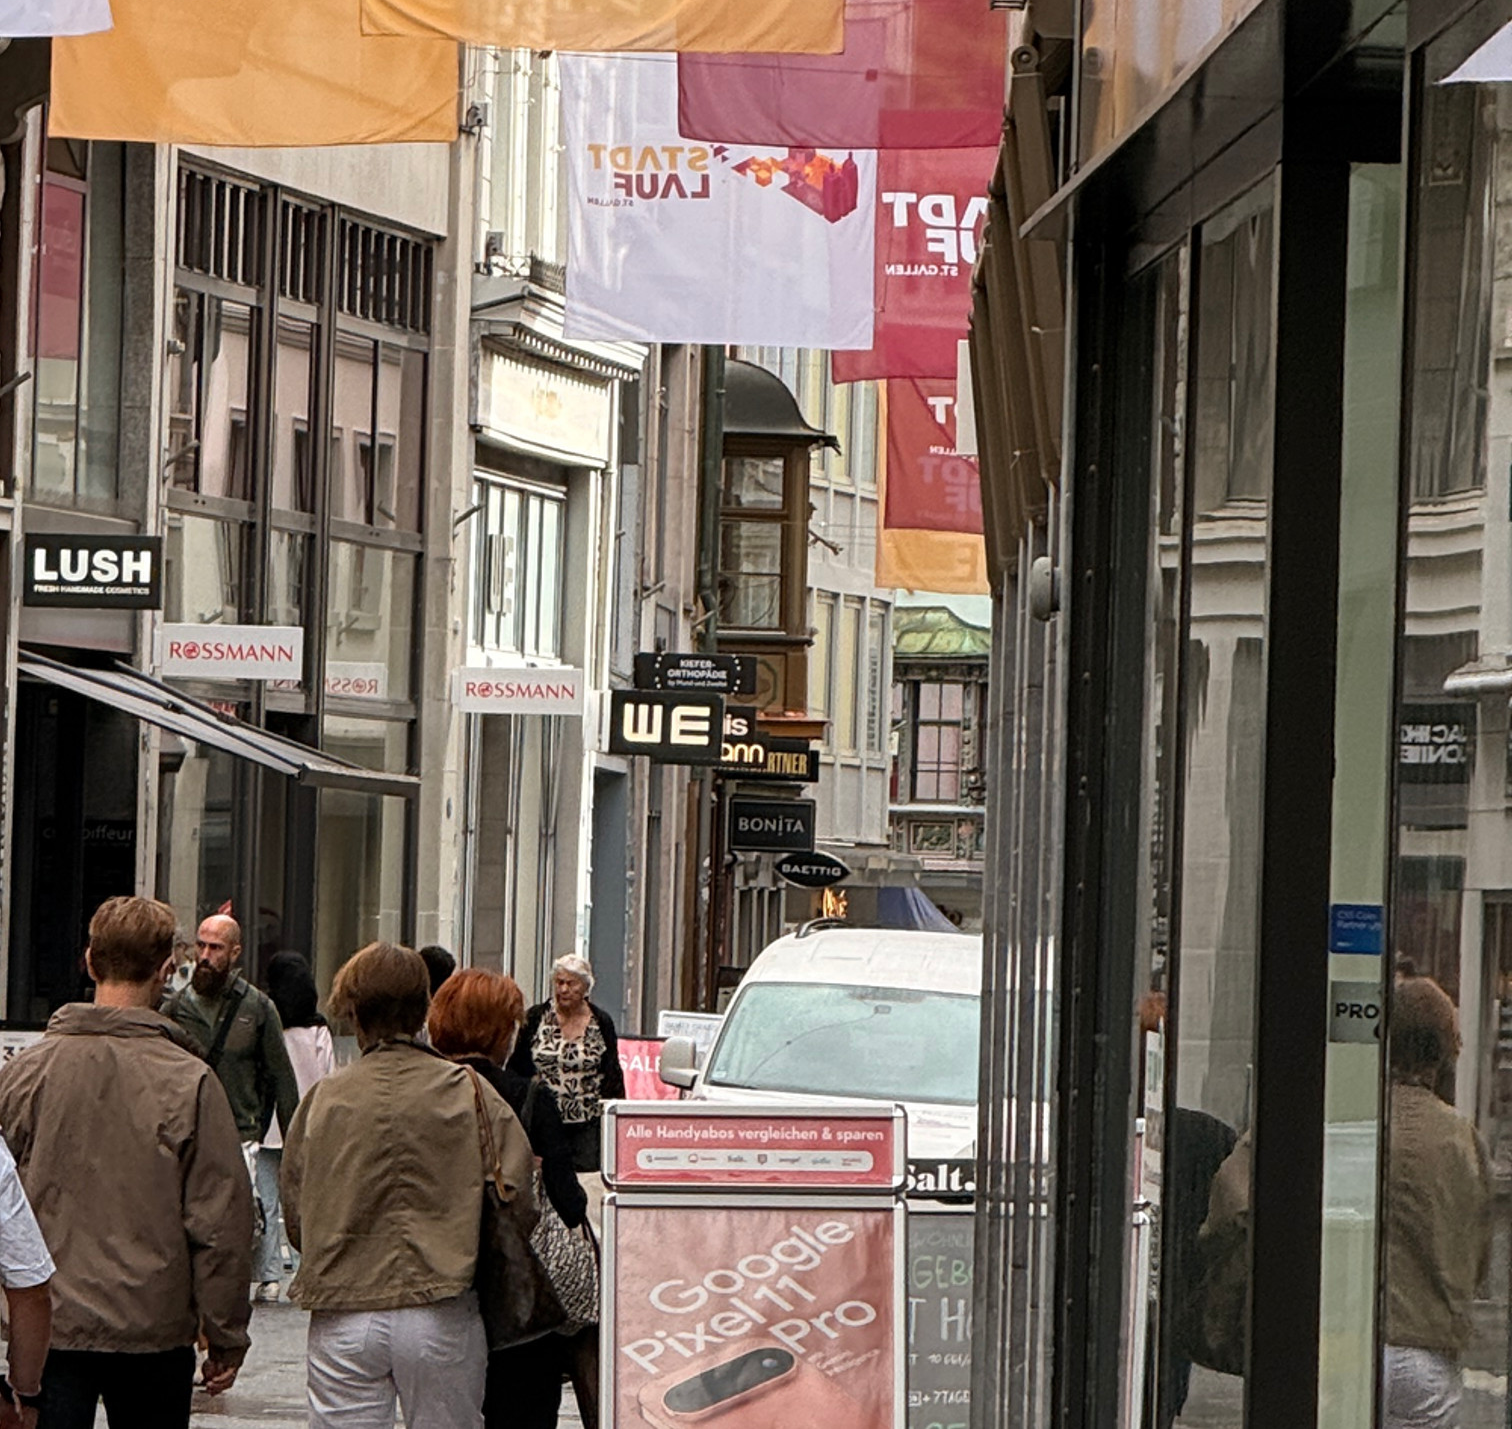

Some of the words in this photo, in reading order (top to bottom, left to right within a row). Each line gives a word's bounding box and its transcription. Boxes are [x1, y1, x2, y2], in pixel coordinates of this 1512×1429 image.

[34, 548, 151, 583] LUSH
[169, 642, 293, 662] ROSSMANN
[465, 681, 575, 700] ROSSMANN
[623, 703, 710, 745] WE
[738, 815, 805, 836] BONITA
[781, 864, 842, 877] BAETTIG
[626, 1124, 652, 1138] Alle
[656, 1125, 735, 1142] Handyabos
[737, 1125, 818, 1143] vergleichen
[822, 1127, 833, 1140] &
[836, 1129, 884, 1143] sparen
[648, 1220, 855, 1315] Google
[912, 1255, 973, 1289] GEB
[621, 1299, 765, 1374] Pixel
[768, 1299, 877, 1355] Pro
